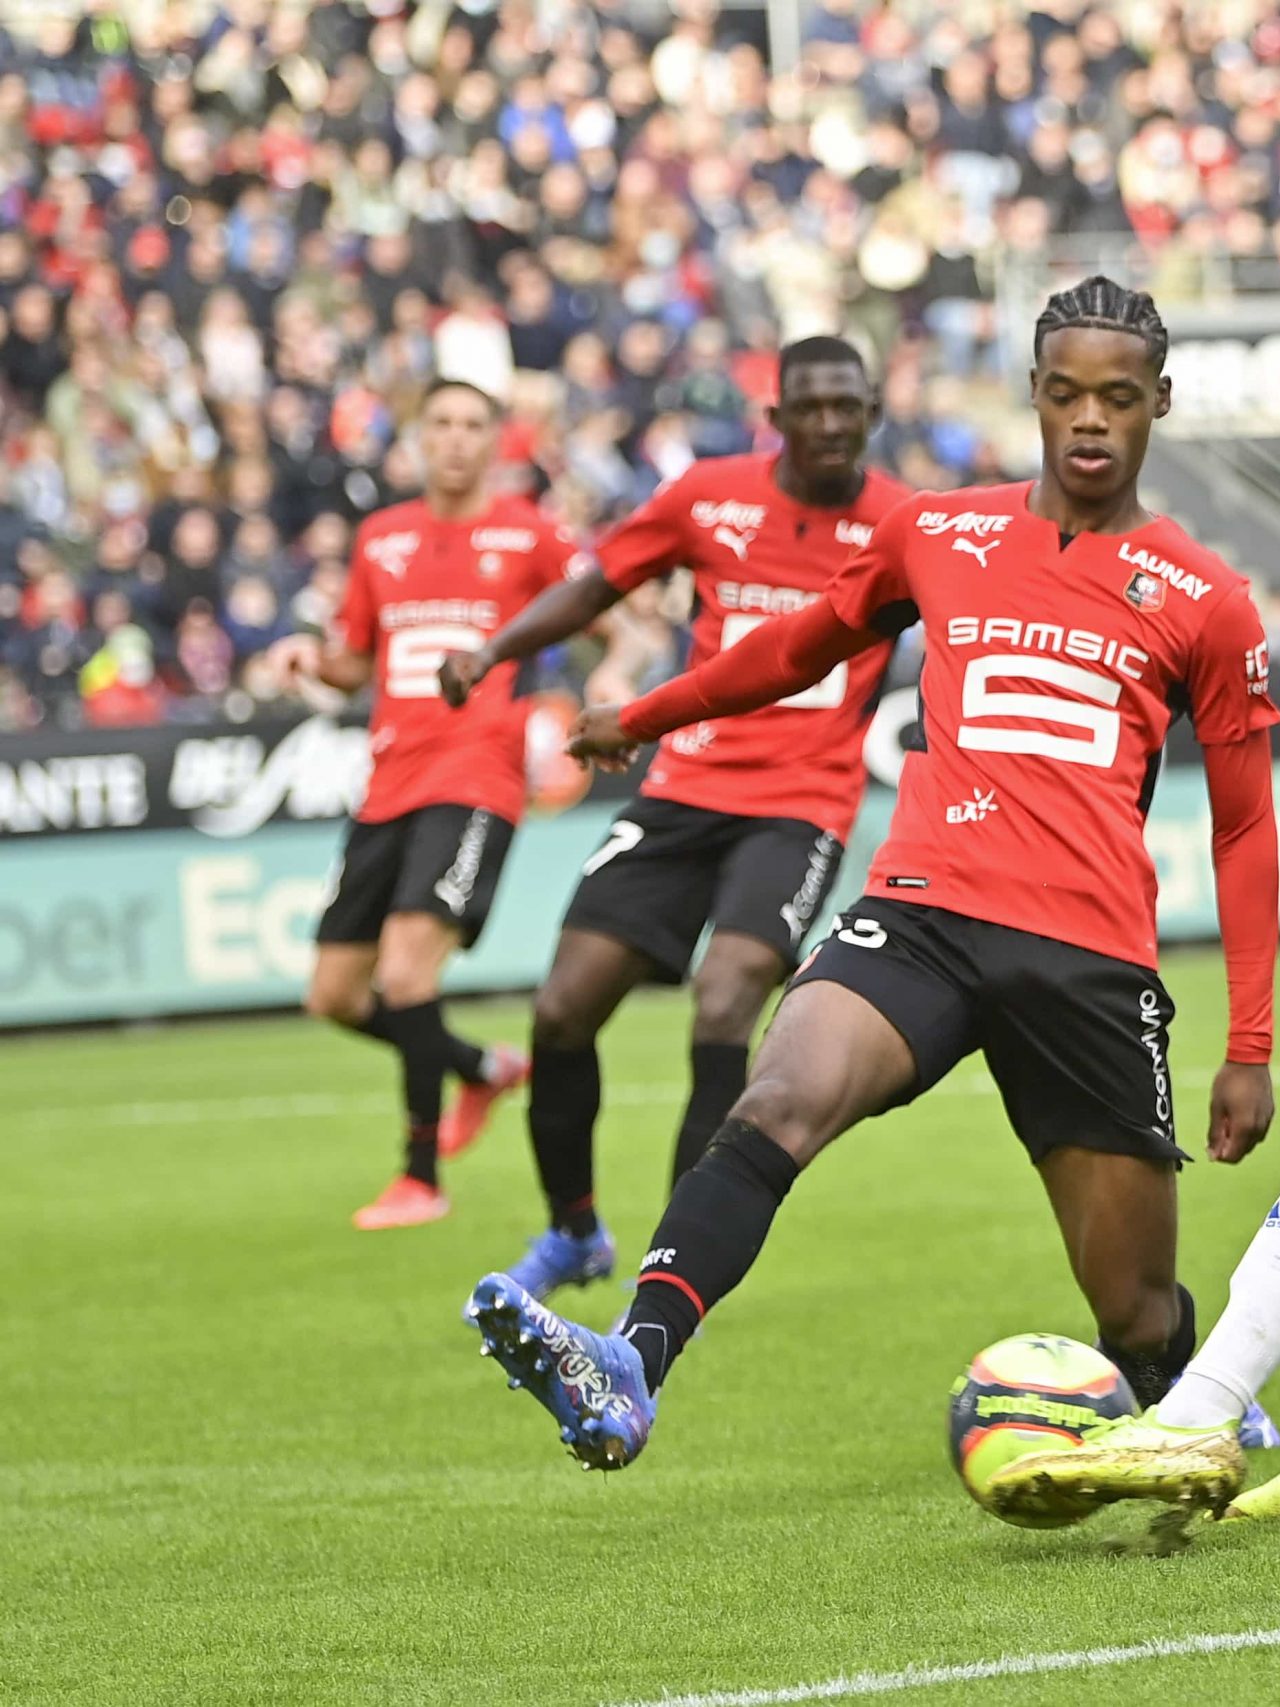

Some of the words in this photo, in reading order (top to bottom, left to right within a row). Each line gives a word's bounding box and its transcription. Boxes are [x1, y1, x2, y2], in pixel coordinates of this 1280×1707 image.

[932, 511, 1013, 537] ARTE
[1117, 542, 1212, 601] LAUNAY
[948, 617, 1149, 681] SAMSIC
[583, 819, 645, 876] 7
